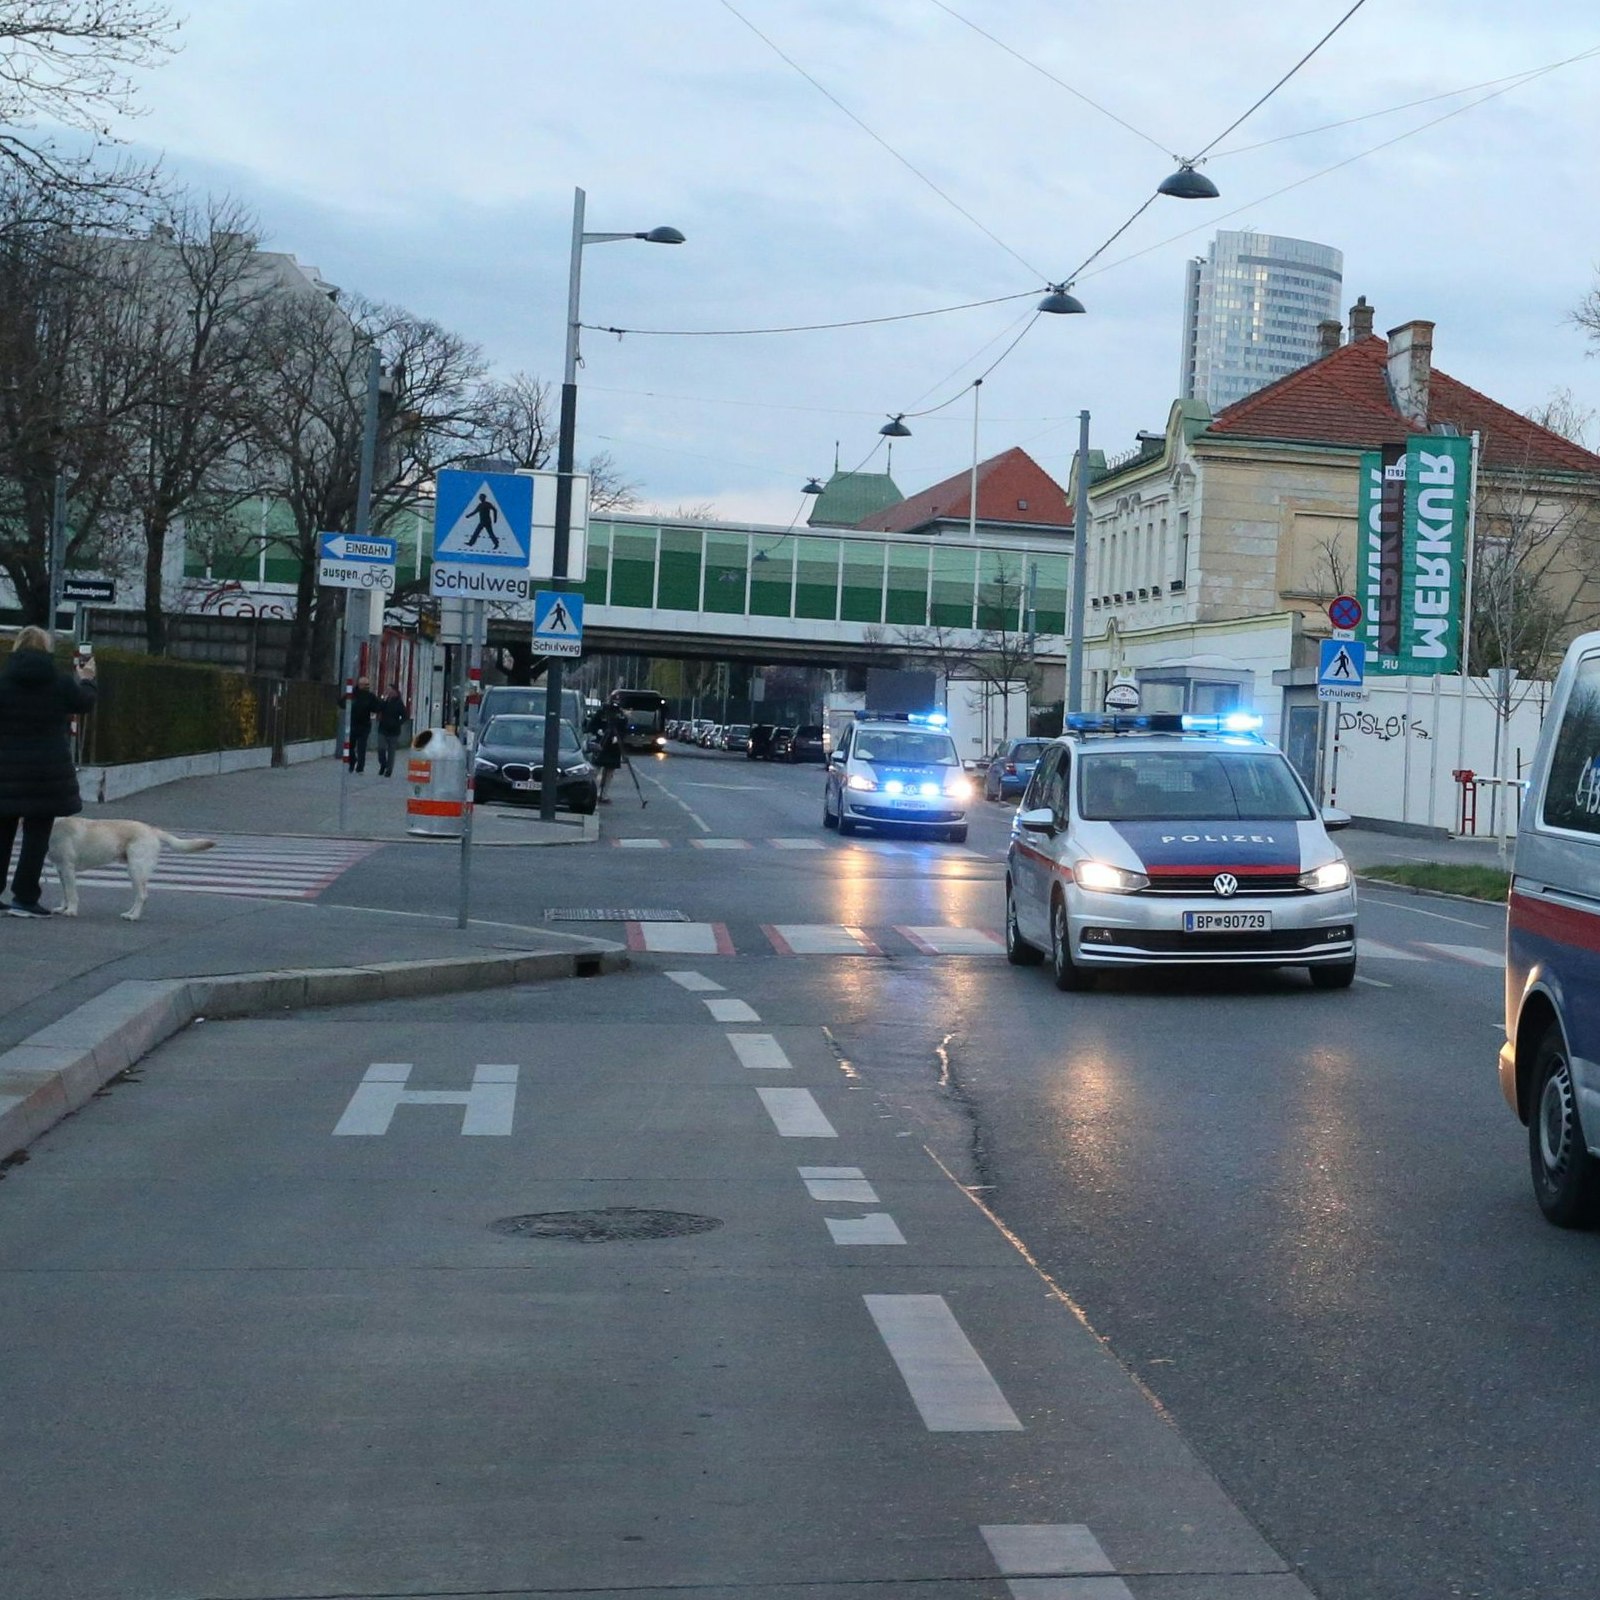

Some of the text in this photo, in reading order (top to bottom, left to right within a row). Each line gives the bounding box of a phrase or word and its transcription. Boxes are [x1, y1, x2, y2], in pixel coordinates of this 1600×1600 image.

[345, 542, 388, 556] EINBAHN
[434, 568, 528, 598] Schulweg
[533, 640, 581, 655] Schulweg
[1320, 687, 1362, 699] Schulweg
[1161, 834, 1275, 844] POLIZEI
[1197, 915, 1265, 928] BP 90729
[331, 1063, 519, 1136] H
